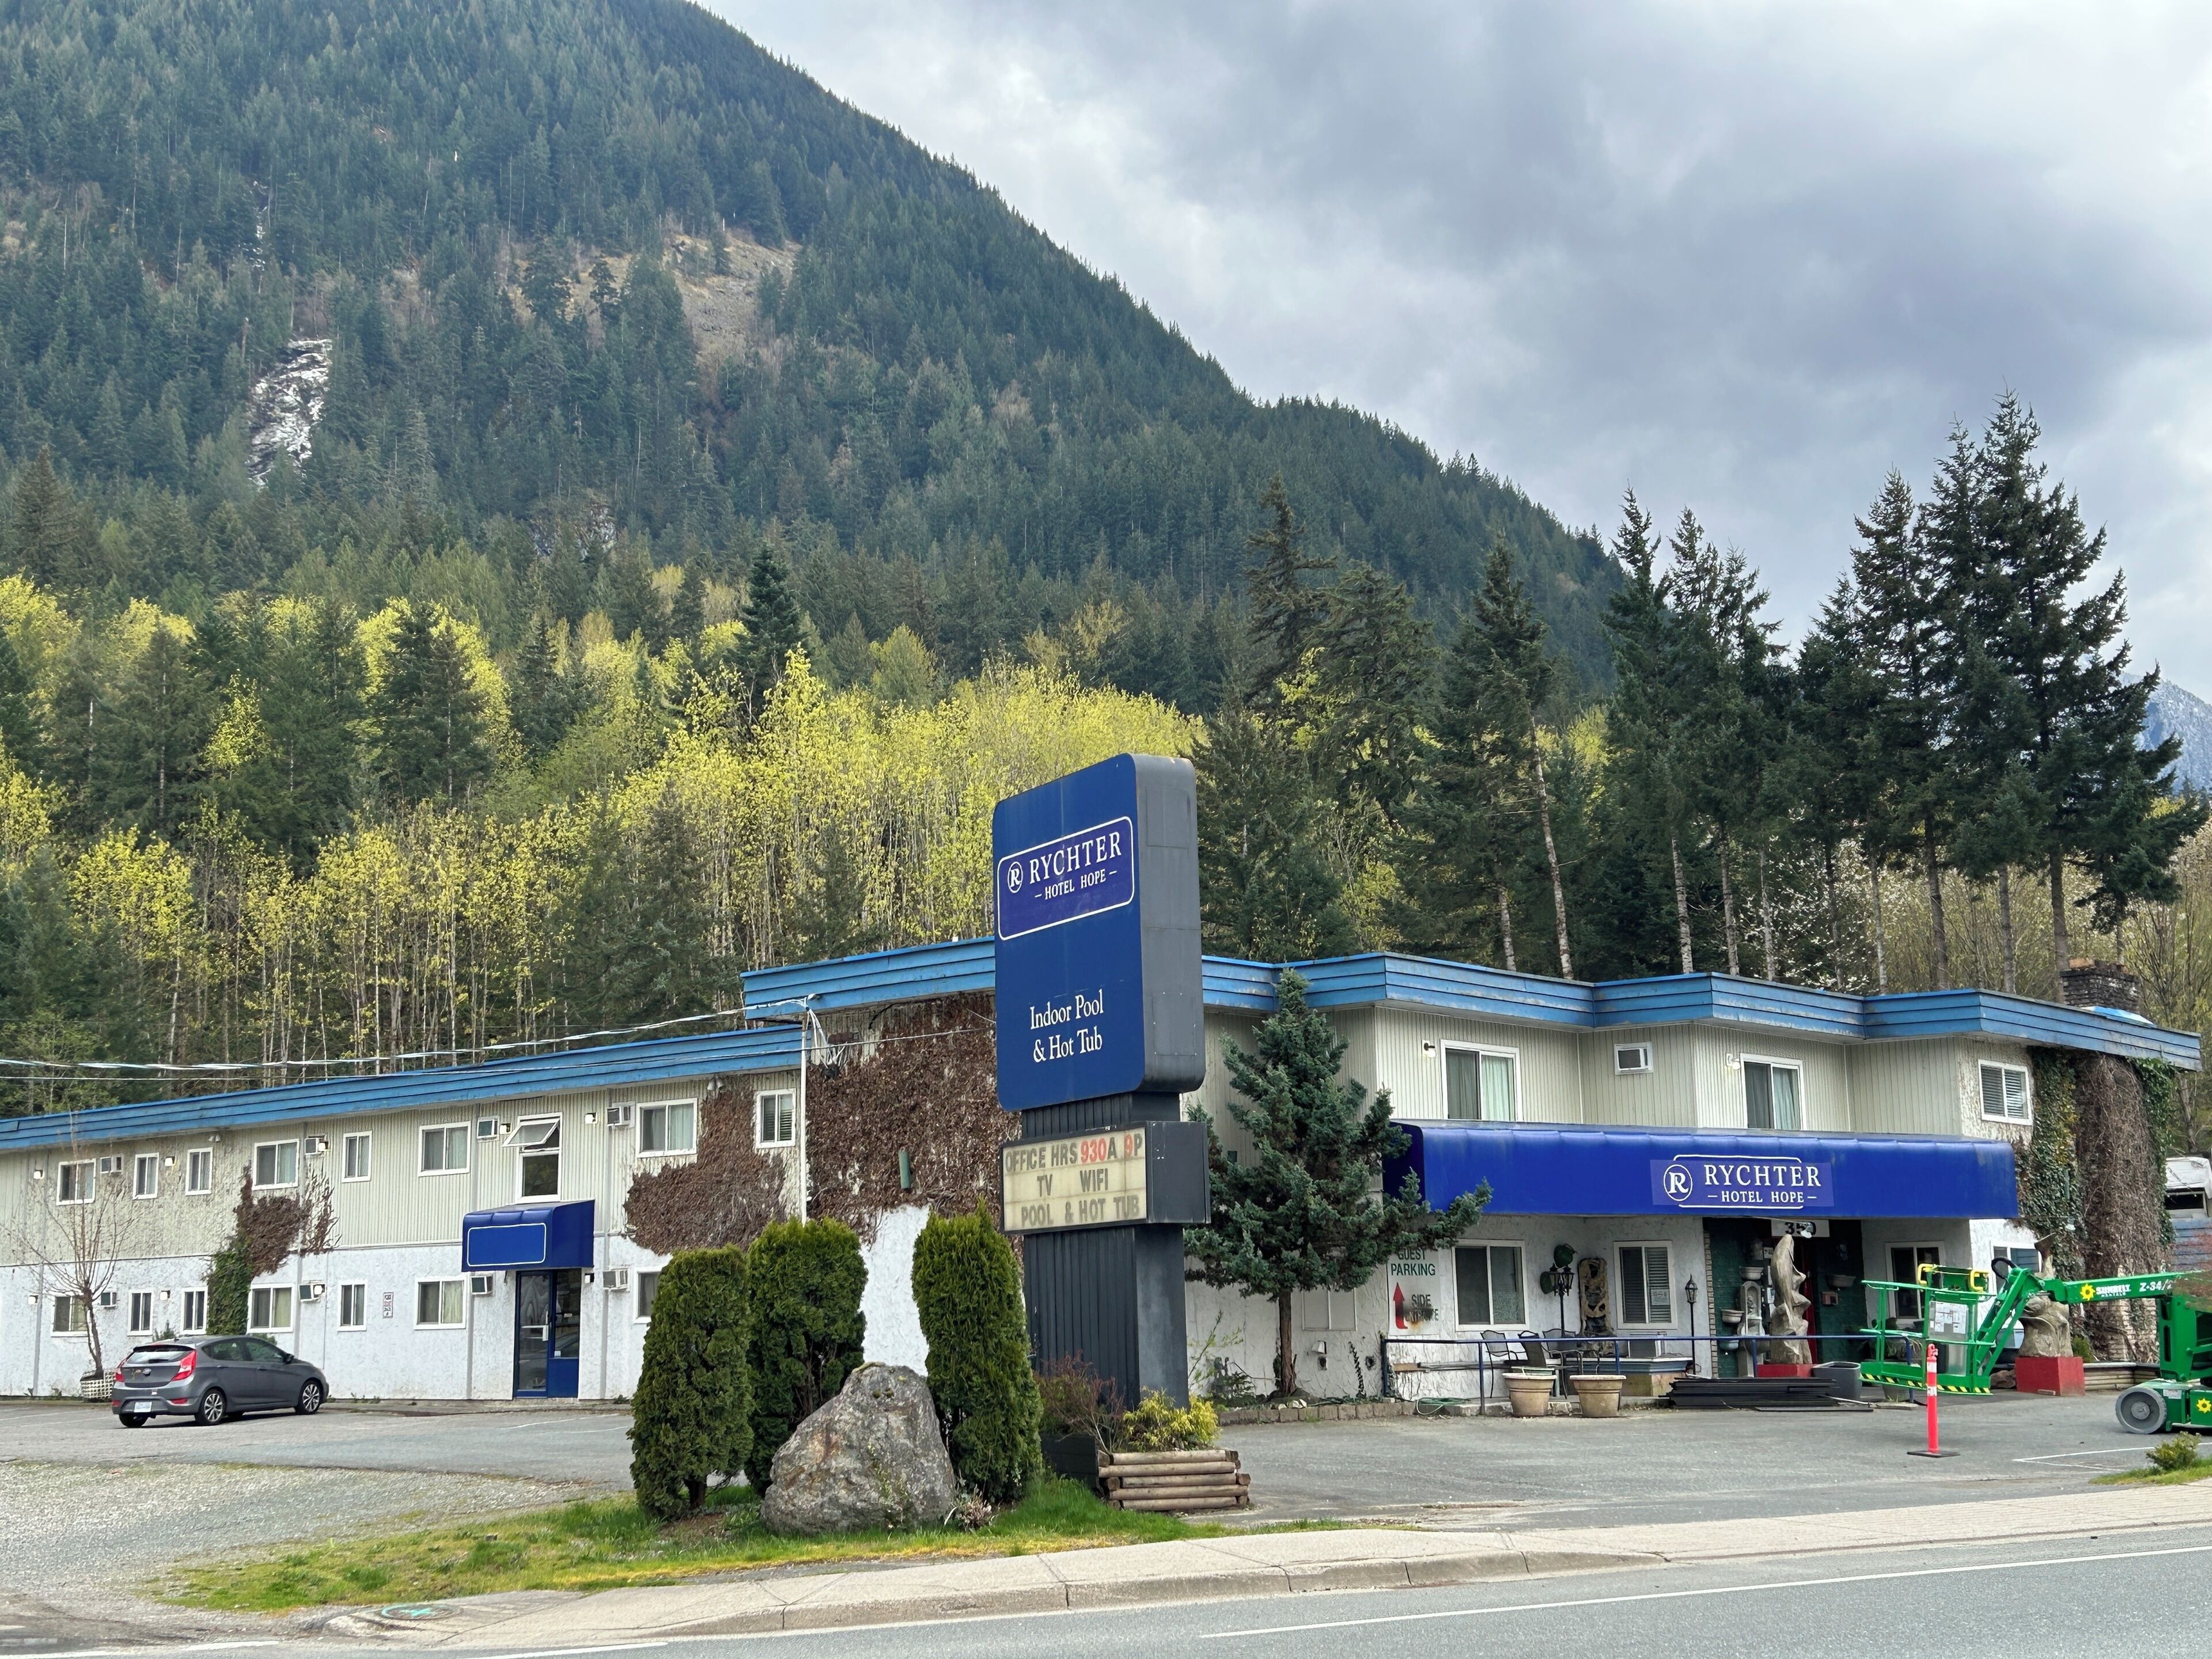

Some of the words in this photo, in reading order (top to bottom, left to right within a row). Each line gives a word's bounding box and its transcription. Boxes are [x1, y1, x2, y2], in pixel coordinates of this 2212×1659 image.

[1029, 831, 1122, 884] RYCHTER
[1044, 879, 1075, 900] HOTEL
[1080, 869, 1106, 889] HOPE
[1030, 1001, 1072, 1030] Indoor
[1075, 988, 1104, 1020] Pool
[1033, 1039, 1046, 1063] &
[1048, 1033, 1074, 1060] Hot
[1077, 1026, 1103, 1055] Tub
[1005, 1146, 1047, 1172] OFFICE
[1051, 1139, 1078, 1166] HRS
[1037, 1174, 1053, 1197] TV
[1080, 1168, 1109, 1193] WIFI
[1703, 1164, 1822, 1187] RYCHTER
[1021, 1203, 1054, 1228] POOL
[1065, 1200, 1074, 1225] &
[1078, 1198, 1107, 1223] HOT
[1113, 1194, 1140, 1220] TUB
[1721, 1190, 1763, 1203] HOTEL
[1771, 1191, 1804, 1203] HOPE
[1391, 1263, 1435, 1276] PARKING
[1412, 1294, 1431, 1307] SIDE
